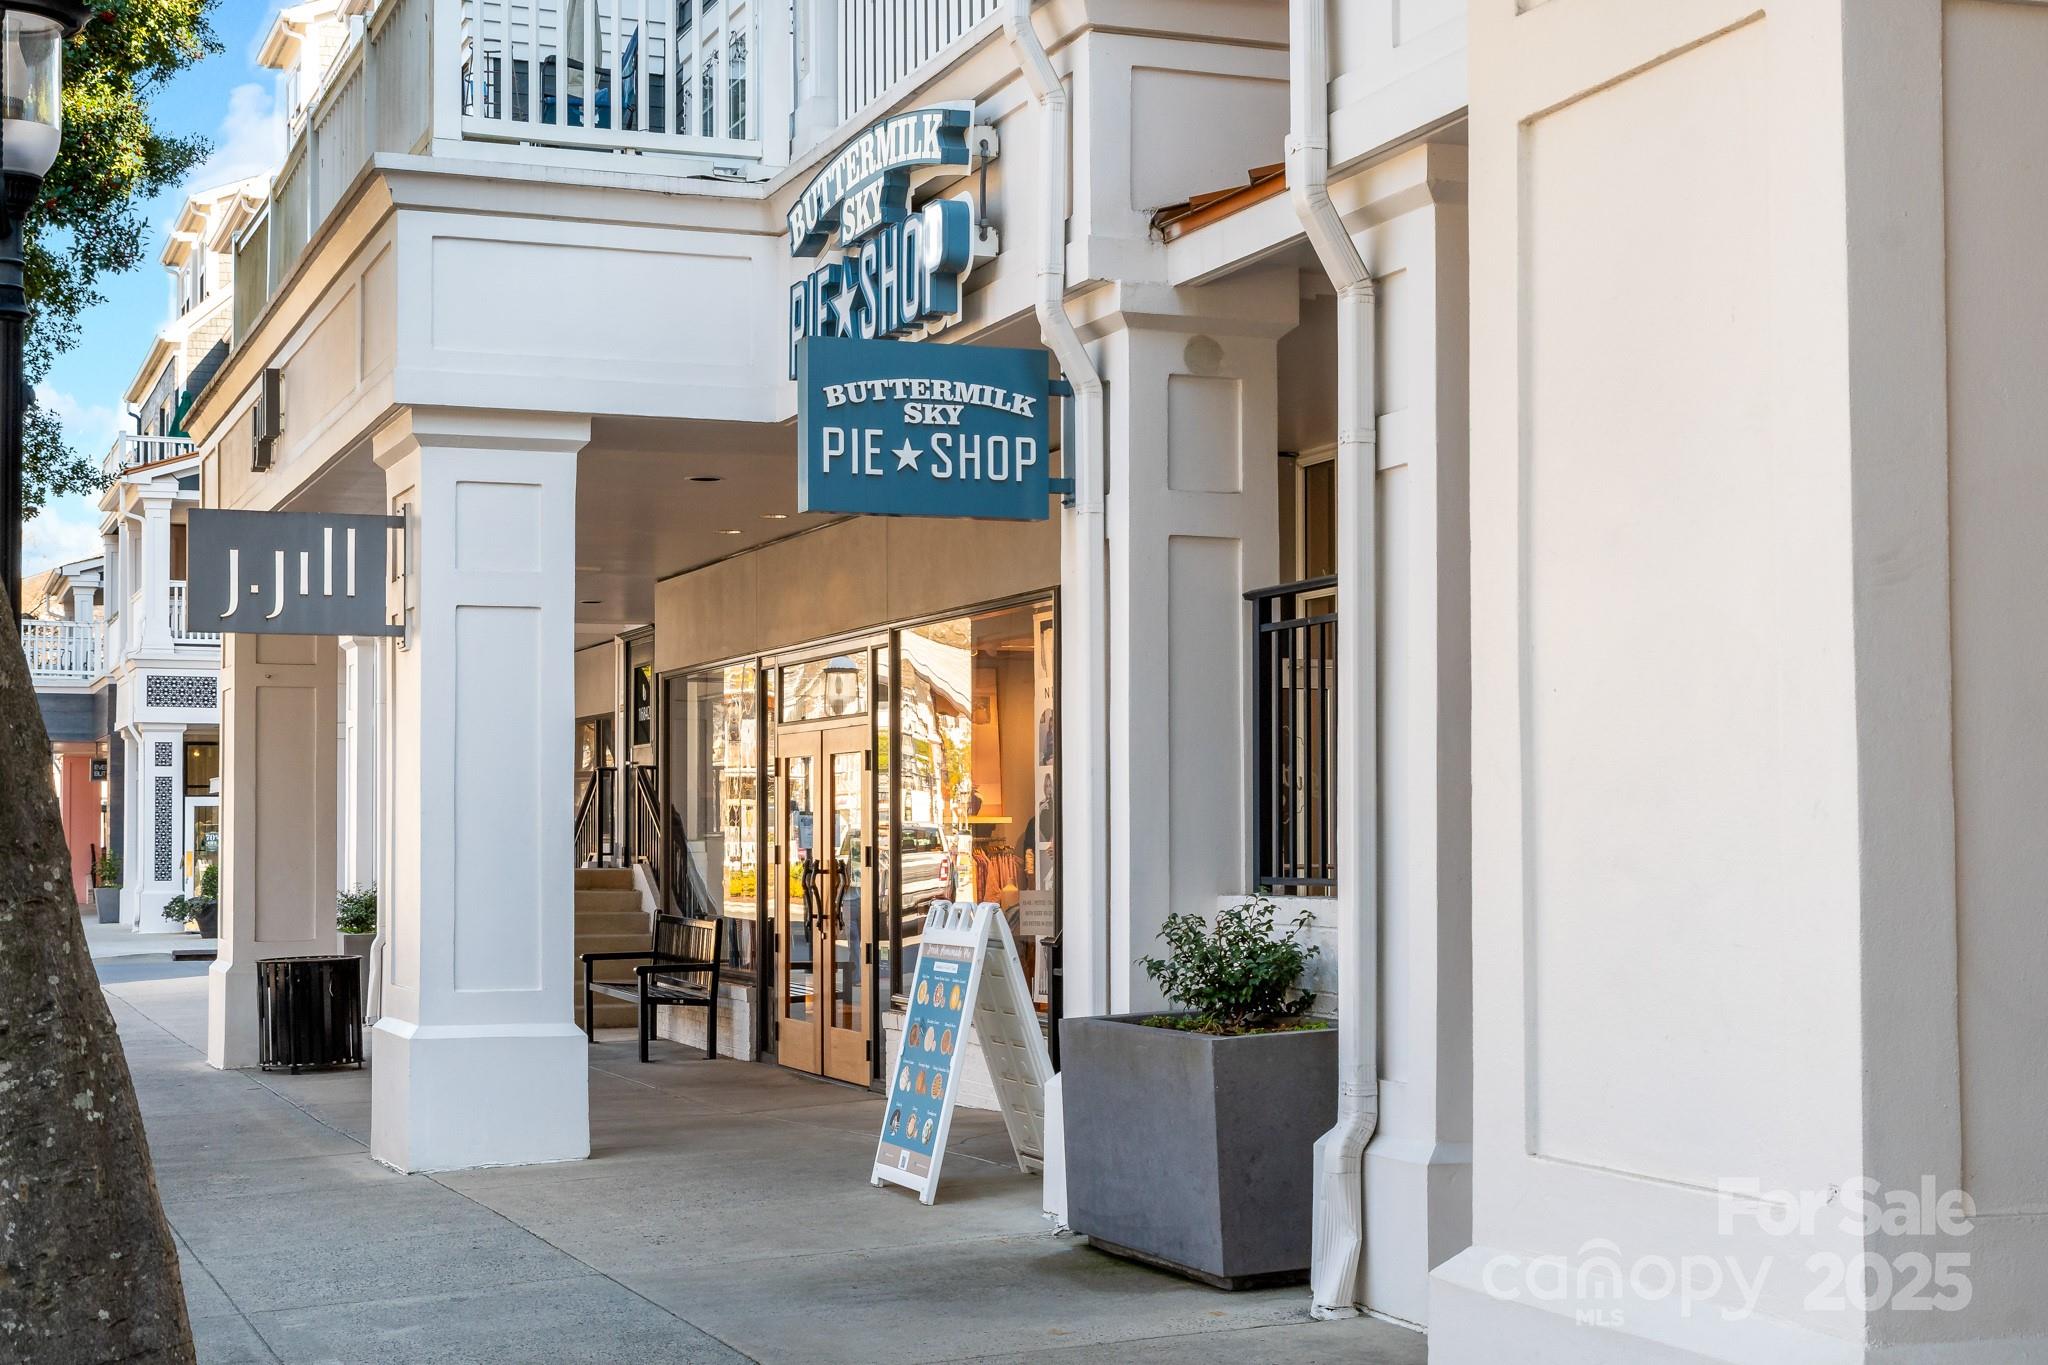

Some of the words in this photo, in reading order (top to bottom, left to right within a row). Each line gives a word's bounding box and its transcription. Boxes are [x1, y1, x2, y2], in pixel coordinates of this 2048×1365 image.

[789, 113, 943, 248] BUTTERMILK
[841, 175, 885, 244] SKY
[790, 265, 831, 379] PIE
[860, 203, 943, 340] SHOP
[823, 378, 1037, 418] BUTTERMILK
[903, 402, 965, 426] SKY
[822, 426, 884, 476] PIE
[930, 432, 1037, 482] SHOP
